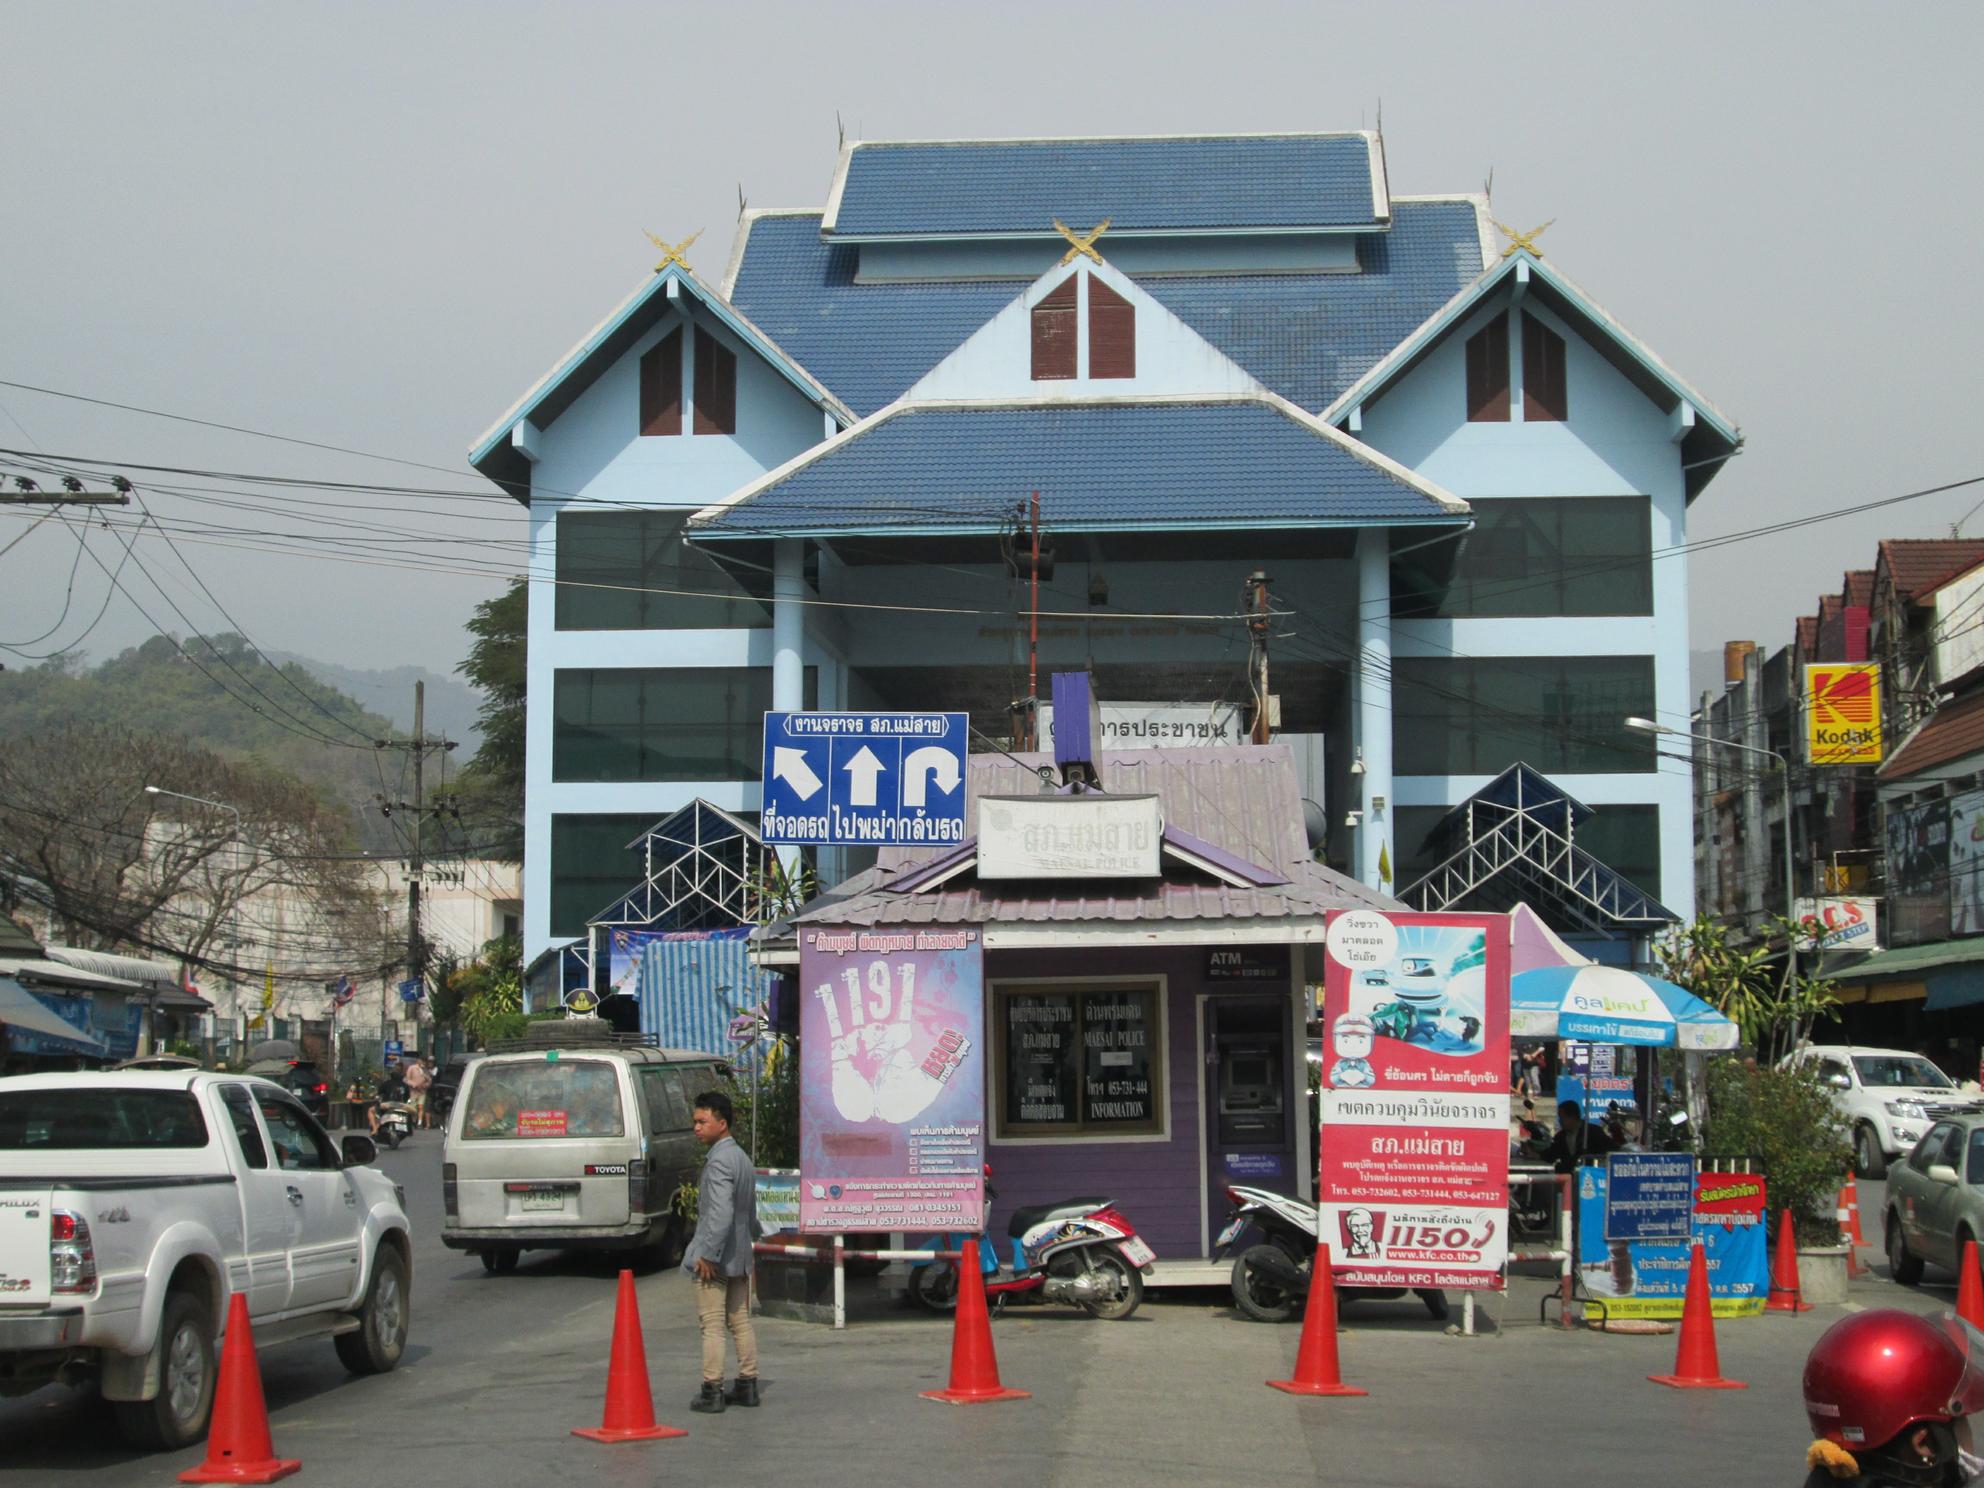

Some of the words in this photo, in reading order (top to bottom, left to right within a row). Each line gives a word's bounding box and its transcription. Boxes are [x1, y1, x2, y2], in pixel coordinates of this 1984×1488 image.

[795, 718, 864, 733] งานจราจร
[870, 716, 941, 734] สภ.แม่สาย
[1816, 728, 1874, 745] Kodak
[764, 799, 828, 839] ที่จอดรถ
[832, 804, 897, 840] ไปพม่า
[899, 808, 964, 841] กลับรถ
[1210, 951, 1242, 965] ATM
[814, 960, 916, 1038] 1191
[1084, 1031, 1114, 1047] MAESAI
[1118, 1030, 1146, 1047] POLICE
[1090, 1101, 1144, 1119] INFORMATION
[1337, 1098, 1497, 1121] เขตควบคุมวินัยจราจร
[1371, 1131, 1465, 1156] สภ.แม่สาย
[594, 1166, 626, 1174] TOYOTA
[1387, 1225, 1471, 1249] 1150
[1387, 1250, 1469, 1263] www.kfc.co.th
[1408, 1272, 1431, 1283] KFC
